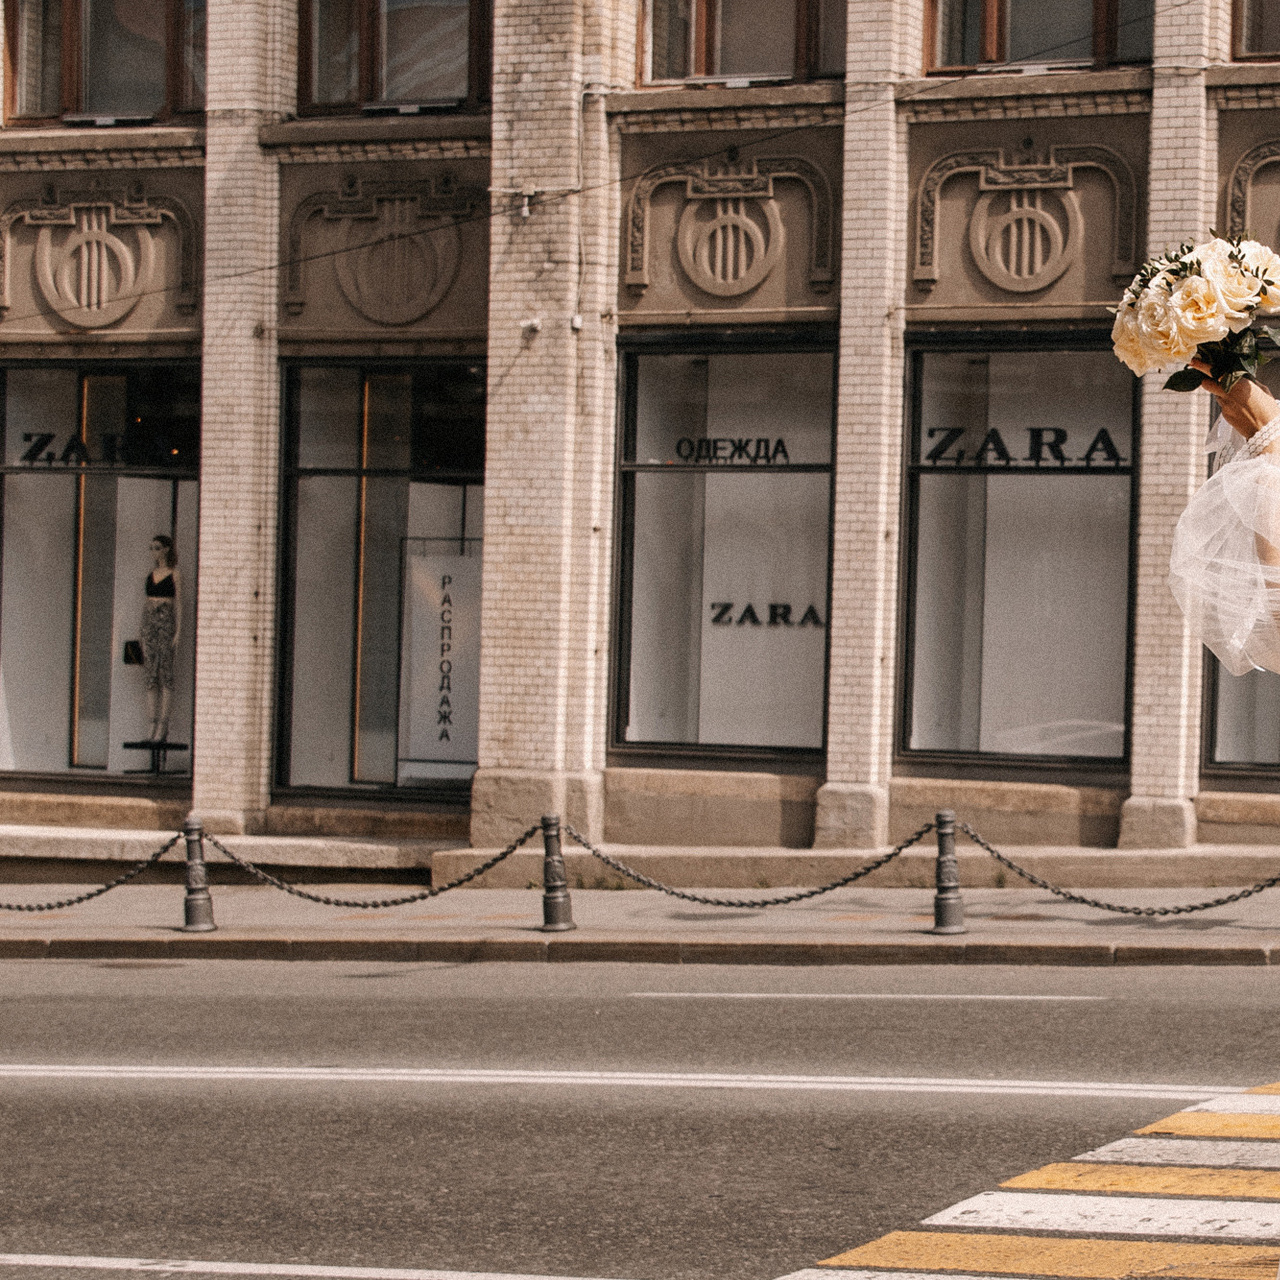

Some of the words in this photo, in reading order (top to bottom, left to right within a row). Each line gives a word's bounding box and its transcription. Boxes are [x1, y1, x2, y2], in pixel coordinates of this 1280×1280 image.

[676, 437, 789, 463] ОДЕЖДА
[925, 427, 1128, 462] ZARA
[711, 602, 826, 628] ZARA
[437, 575, 452, 742] РАСПРОДАЖА
